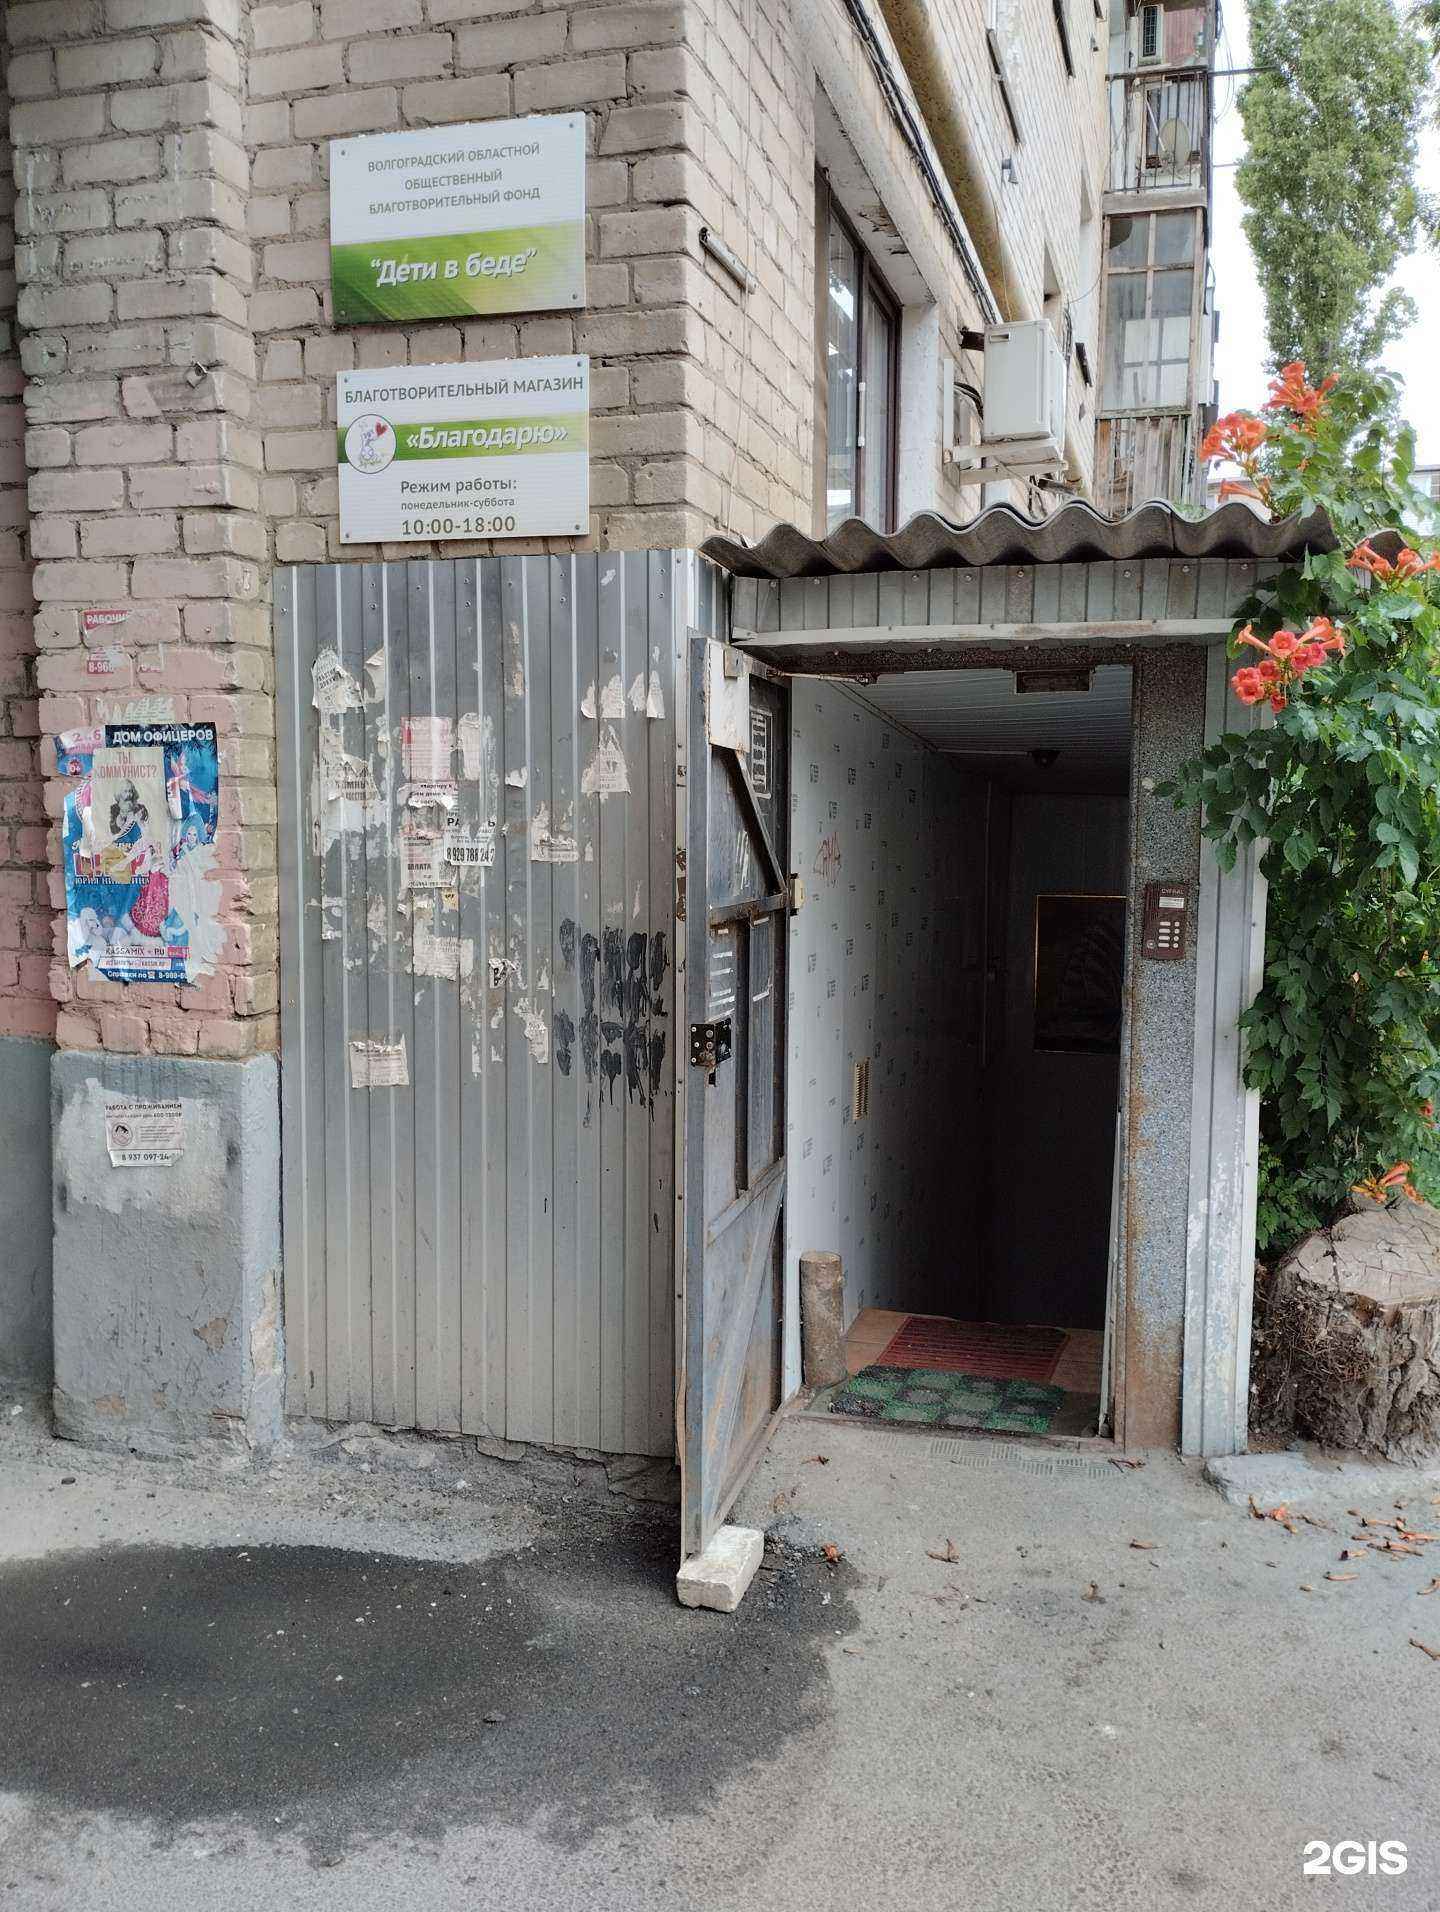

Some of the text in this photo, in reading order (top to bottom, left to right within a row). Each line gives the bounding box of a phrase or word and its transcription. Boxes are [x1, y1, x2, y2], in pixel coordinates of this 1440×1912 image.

[368, 142, 540, 172] ВОЛГОГРАДСКИЙ ОБЛАСТНОЙ
[404, 170, 502, 190] ОБЩЕСТВЕННЫЙ
[369, 187, 541, 215] БЛАГОТВОРИТЕЛЬНЫЙ ФОНД
[444, 259, 459, 278] в
[345, 376, 583, 403] БЛАГОТВОРИТЕЛЬНЫЙ МАГАЗИН
[407, 424, 568, 450] «Благодарю»
[401, 477, 517, 494] Режим работы:
[401, 497, 515, 511] понедельник-суббота
[401, 516, 516, 535] 10:00-18:00
[113, 729, 213, 744] ДОМ ОФИЦЕРОВ
[118, 752, 131, 763] ТЫ
